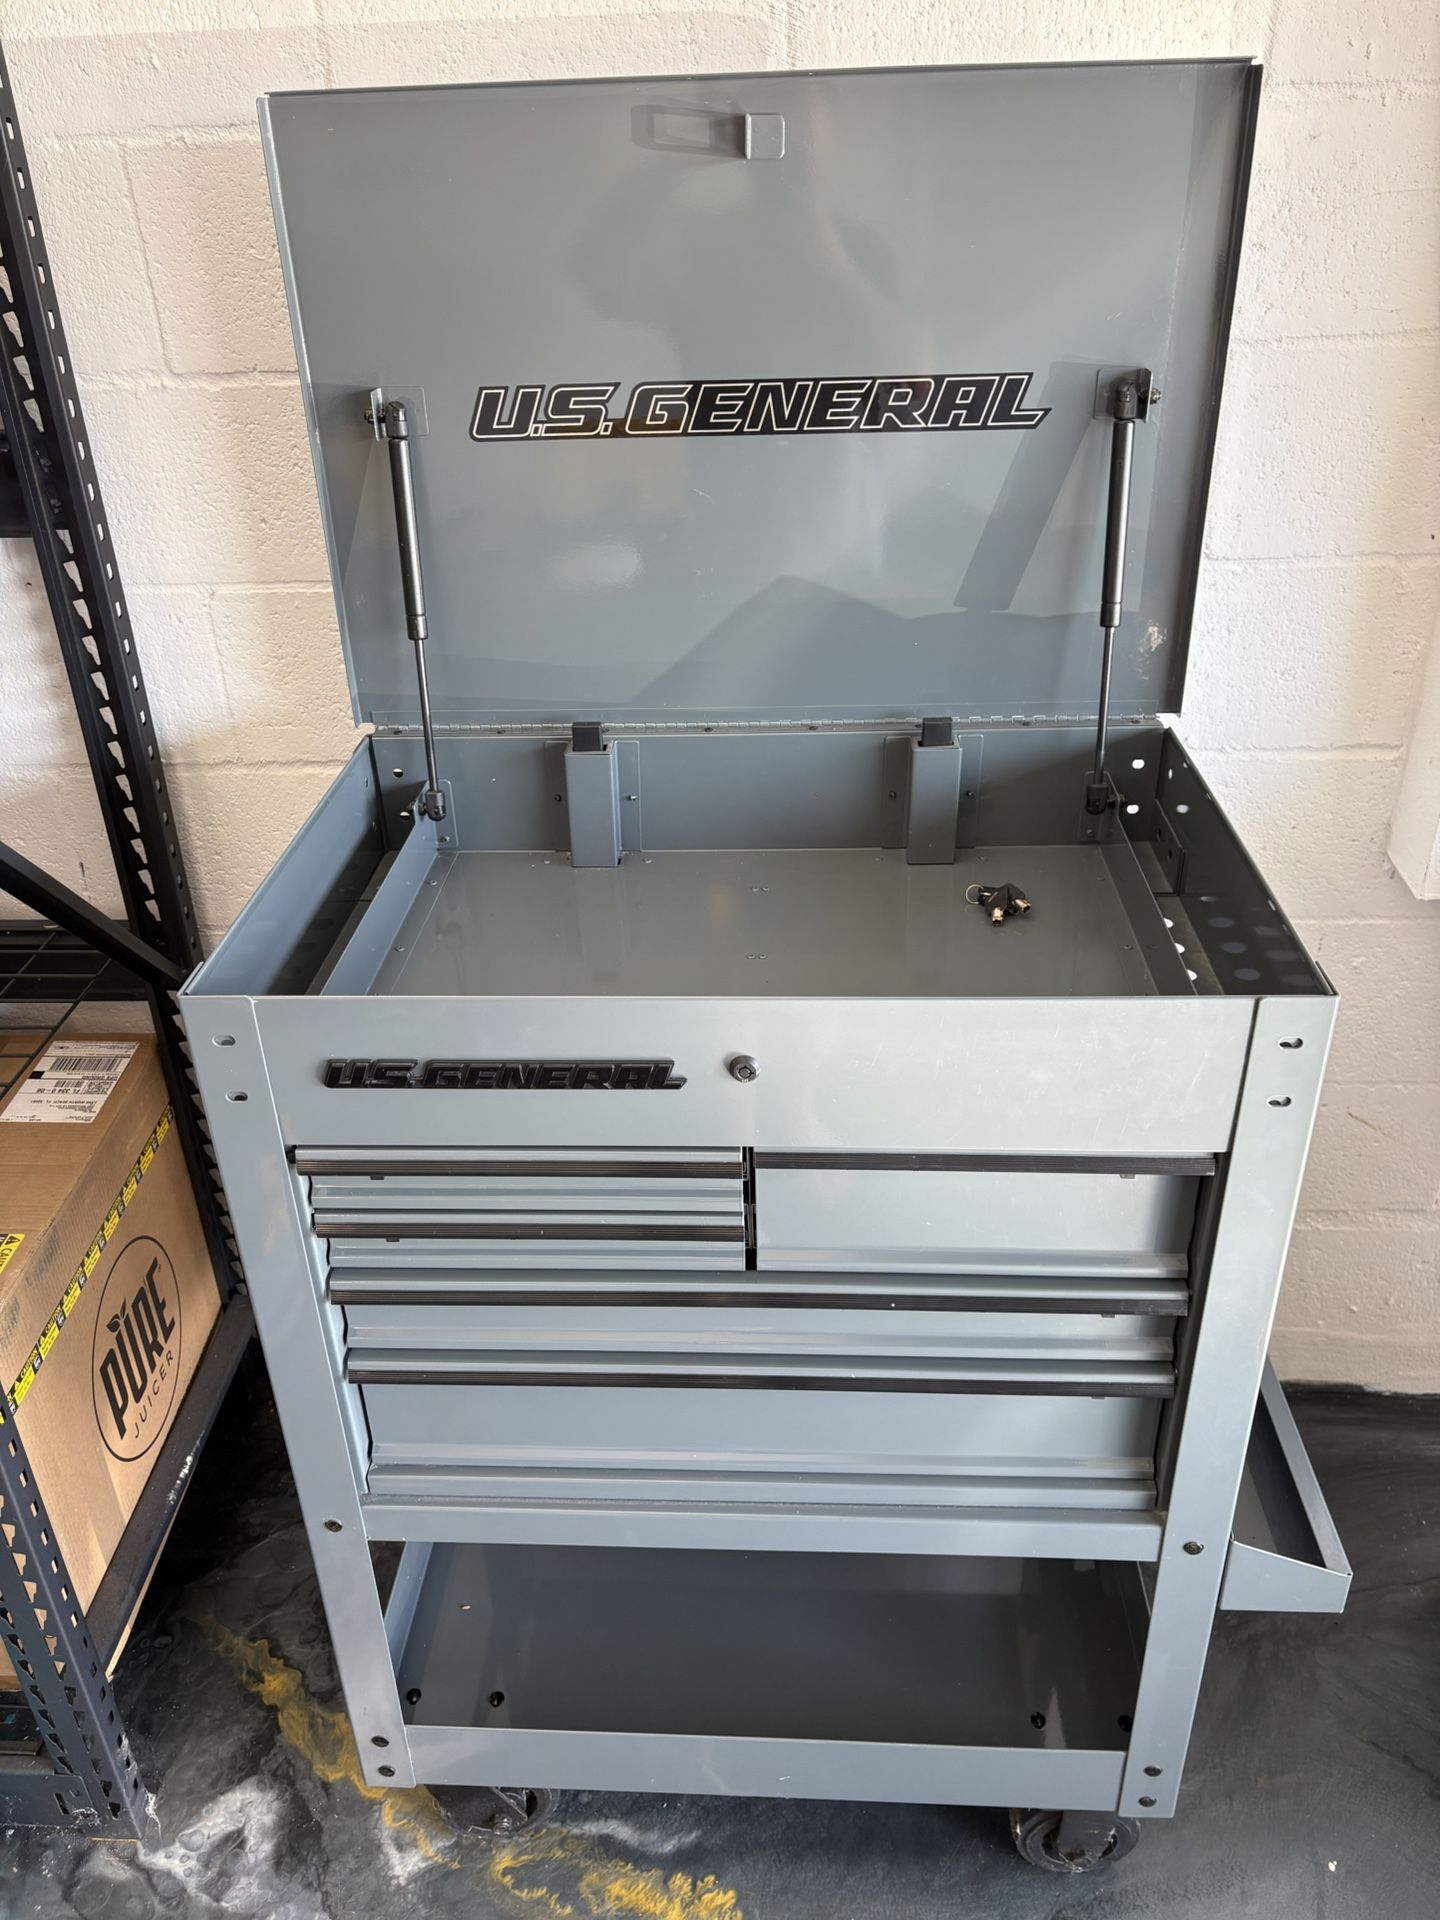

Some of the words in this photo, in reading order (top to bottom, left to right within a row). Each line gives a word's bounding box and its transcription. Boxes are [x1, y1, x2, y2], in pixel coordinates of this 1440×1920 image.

[44, 1304, 62, 1334] CAUTION
[100, 1256, 176, 1440] PURE
[20, 1346, 40, 1379] CAUTION
[134, 1349, 174, 1439] JUICER
